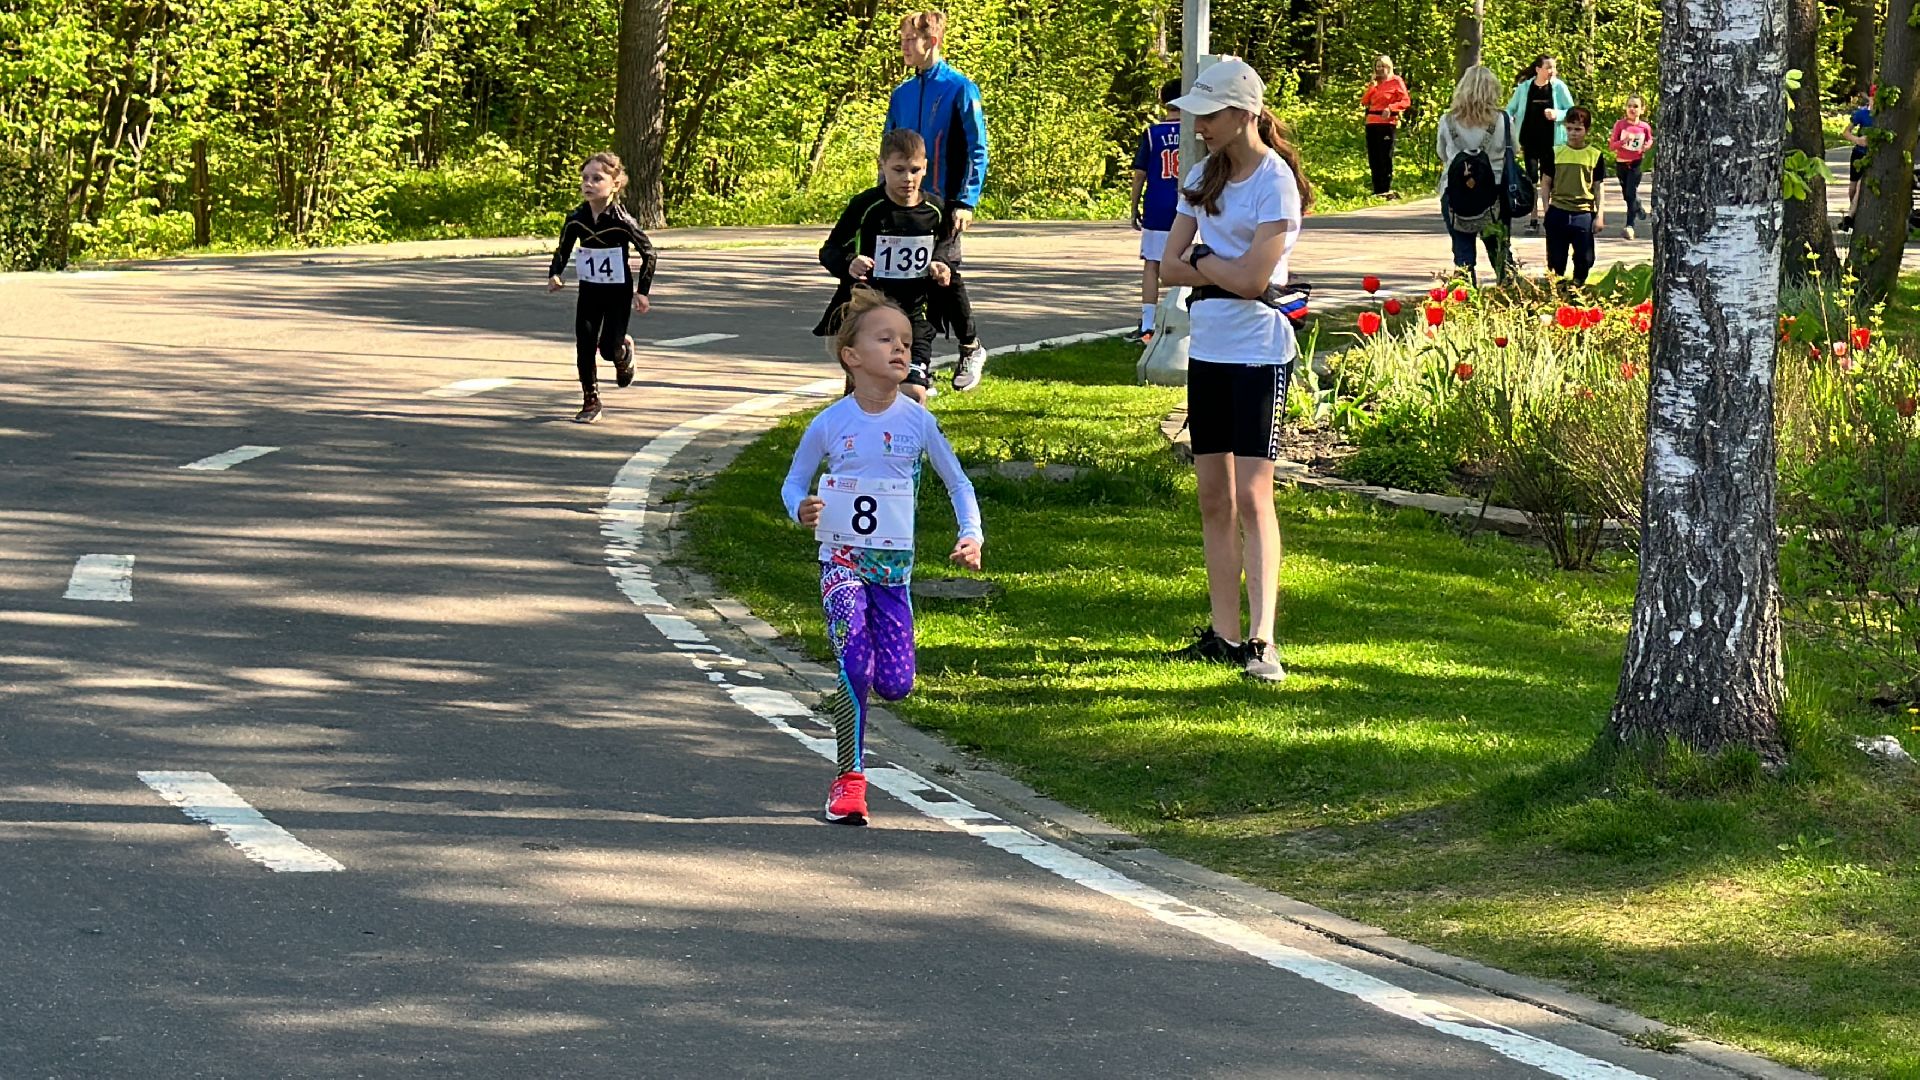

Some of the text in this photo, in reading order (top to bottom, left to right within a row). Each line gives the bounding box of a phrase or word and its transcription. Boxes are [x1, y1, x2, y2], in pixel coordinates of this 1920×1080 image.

[585, 256, 613, 277] 14
[880, 246, 928, 272] 139
[851, 495, 878, 535] 8
